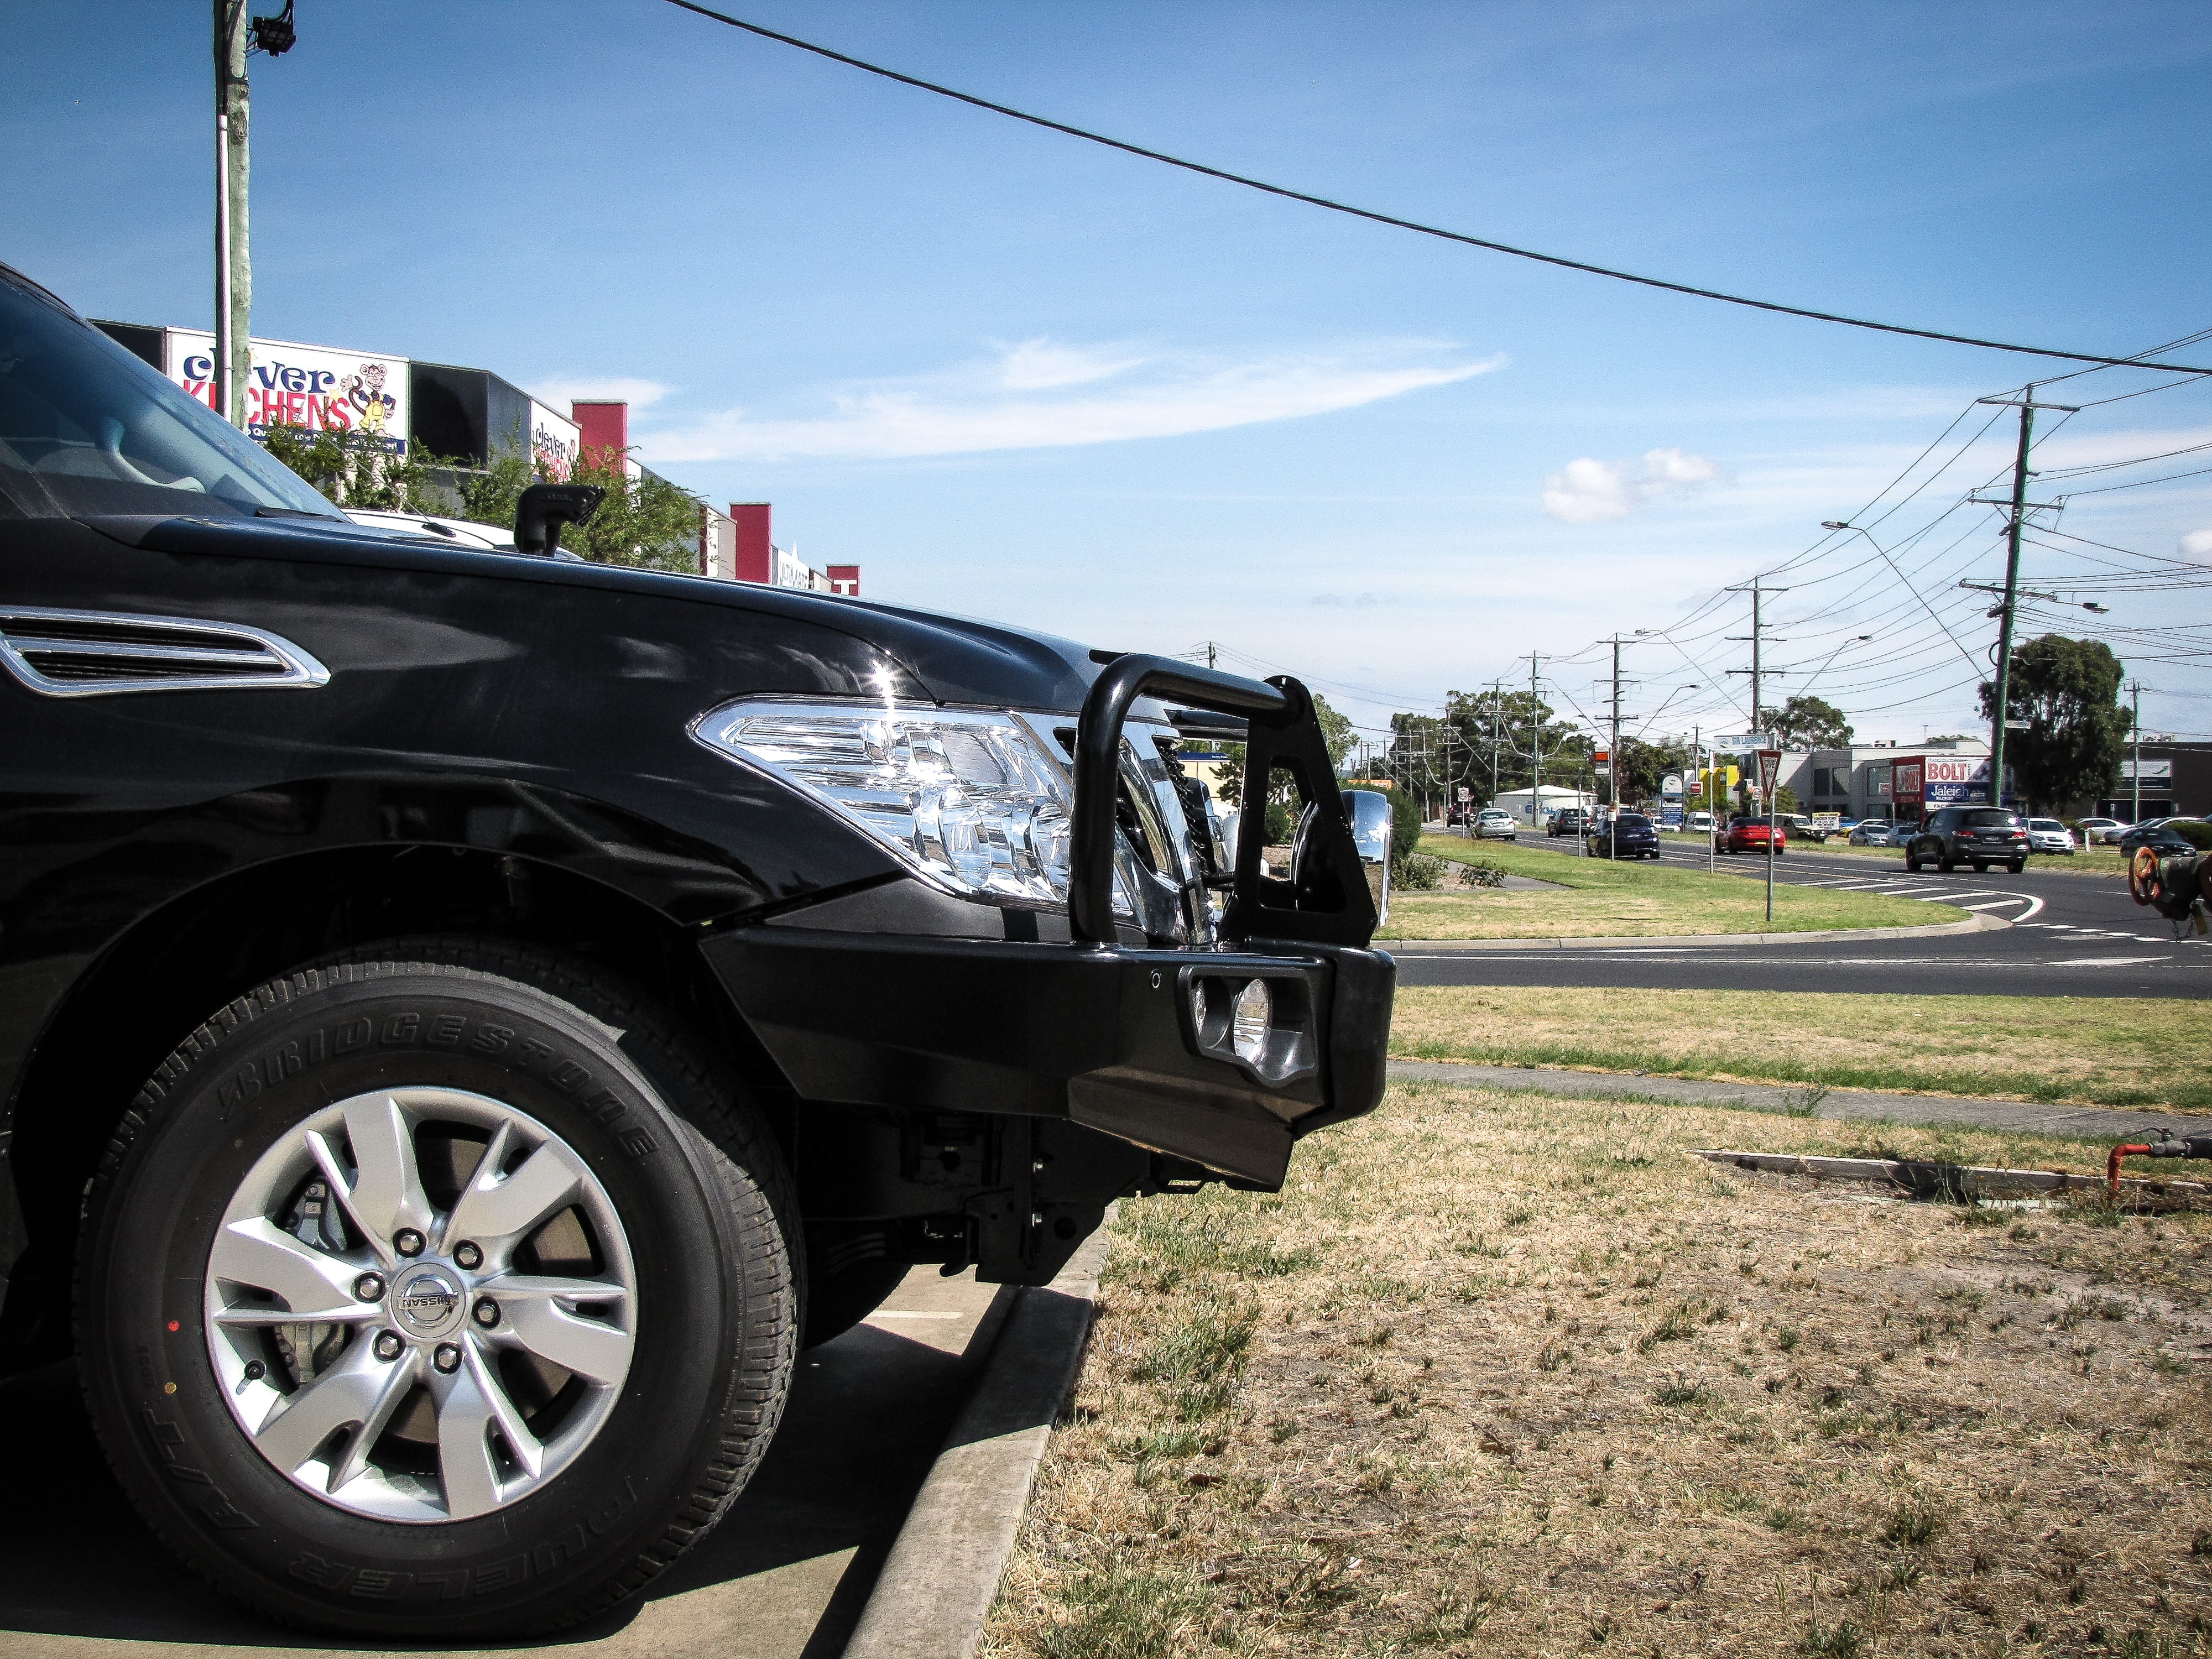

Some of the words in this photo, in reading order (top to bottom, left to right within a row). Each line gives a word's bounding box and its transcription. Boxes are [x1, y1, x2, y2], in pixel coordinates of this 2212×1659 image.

[184, 347, 336, 393] cver
[183, 380, 351, 432] KICHENS
[535, 422, 566, 460] clever
[1928, 763, 1966, 780] BOLT
[1931, 785, 1969, 798] Jaleigh
[218, 1011, 660, 1160] BRIDGESTONE
[403, 1296, 450, 1307] NISSAN
[287, 1476, 639, 1600] DUELER
